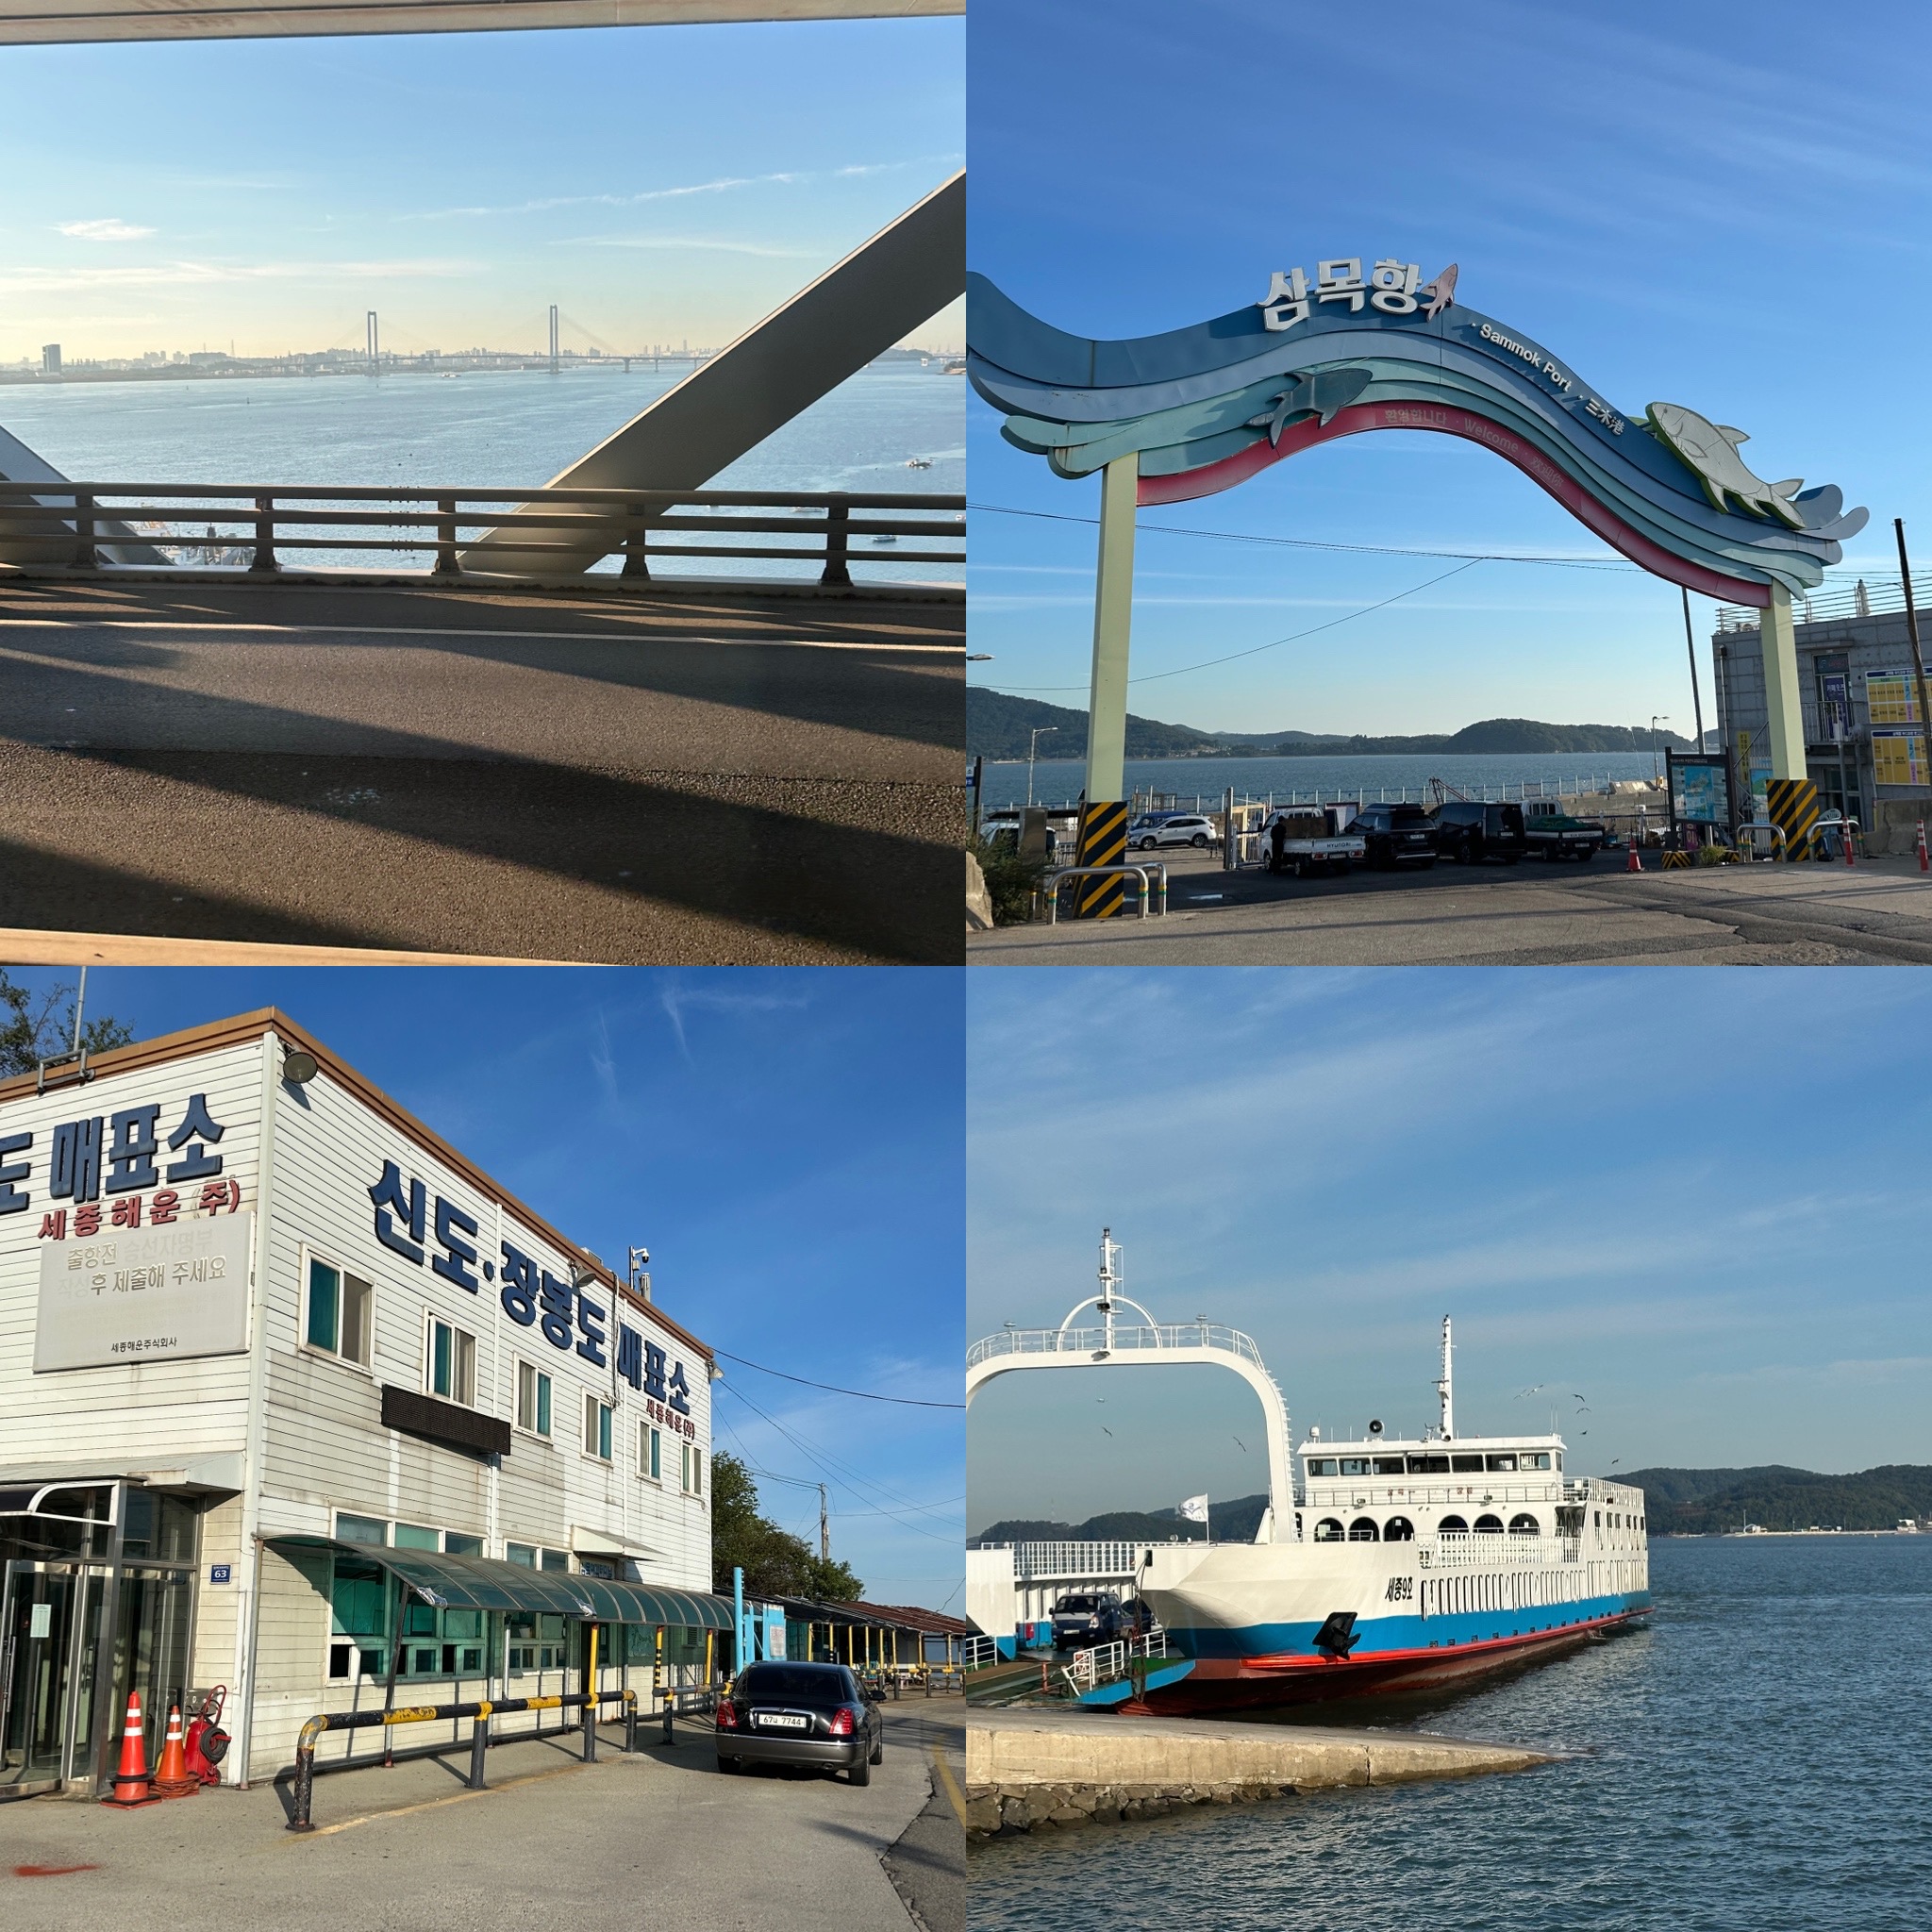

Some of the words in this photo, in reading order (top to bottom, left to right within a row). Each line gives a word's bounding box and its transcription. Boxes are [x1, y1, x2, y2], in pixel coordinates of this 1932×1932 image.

[1257, 258, 1422, 331] 삼목항
[1479, 323, 1541, 368] Sammok
[1542, 361, 1573, 392] Port
[1385, 408, 1447, 425] 환영합니다
[1584, 397, 1624, 436] 三木港
[1464, 417, 1519, 453] Welcome
[50, 1092, 225, 1204] 매표소
[67, 1241, 118, 1271] 출항전
[112, 1262, 166, 1292] 제출해
[172, 1255, 226, 1286] 주세요
[110, 1336, 177, 1353] 세종해운주식회사
[618, 1323, 690, 1415] 매표소
[214, 1570, 227, 1578] 63
[1384, 1576, 1413, 1602] 세종9호
[781, 1717, 802, 1725] 7744
